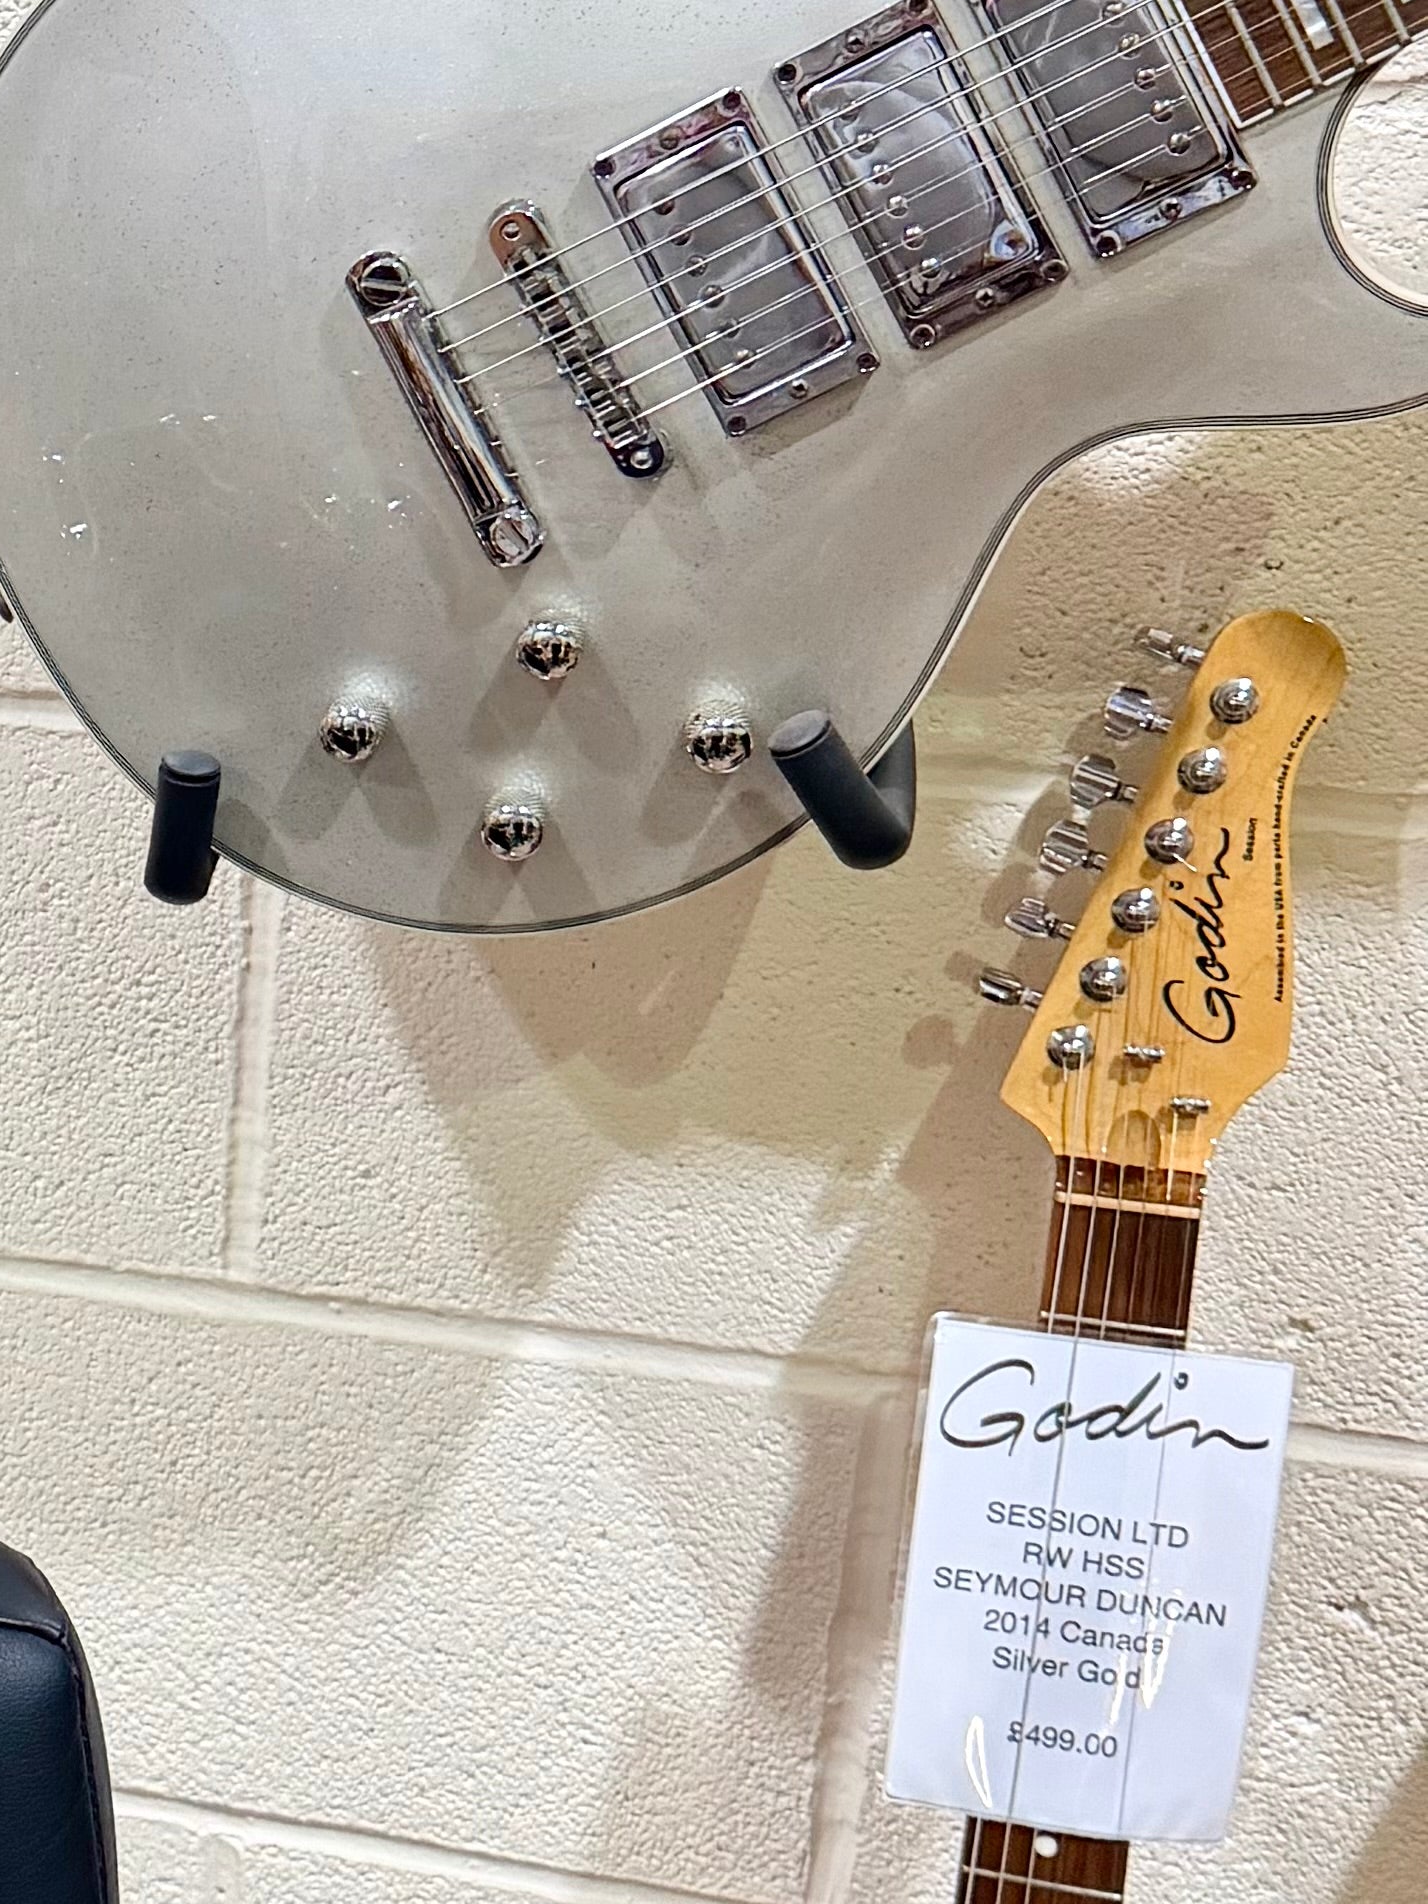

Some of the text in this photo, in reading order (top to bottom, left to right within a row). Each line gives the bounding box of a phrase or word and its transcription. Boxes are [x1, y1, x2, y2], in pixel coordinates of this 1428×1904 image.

[1242, 817, 1257, 861] Session
[1274, 862, 1283, 886] from
[1274, 889, 1284, 911] USA
[1163, 825, 1241, 1044] Godin
[940, 1358, 1270, 1457] Godin
[986, 1501, 1189, 1549] SESSION LTD
[1022, 1542, 1145, 1579] RW HSS
[933, 1566, 1227, 1627] SEYMOUR DUNCAN
[983, 1609, 1051, 1638] 2014
[992, 1648, 1144, 1689] Silver God
[1007, 1721, 1118, 1758] £499.00
